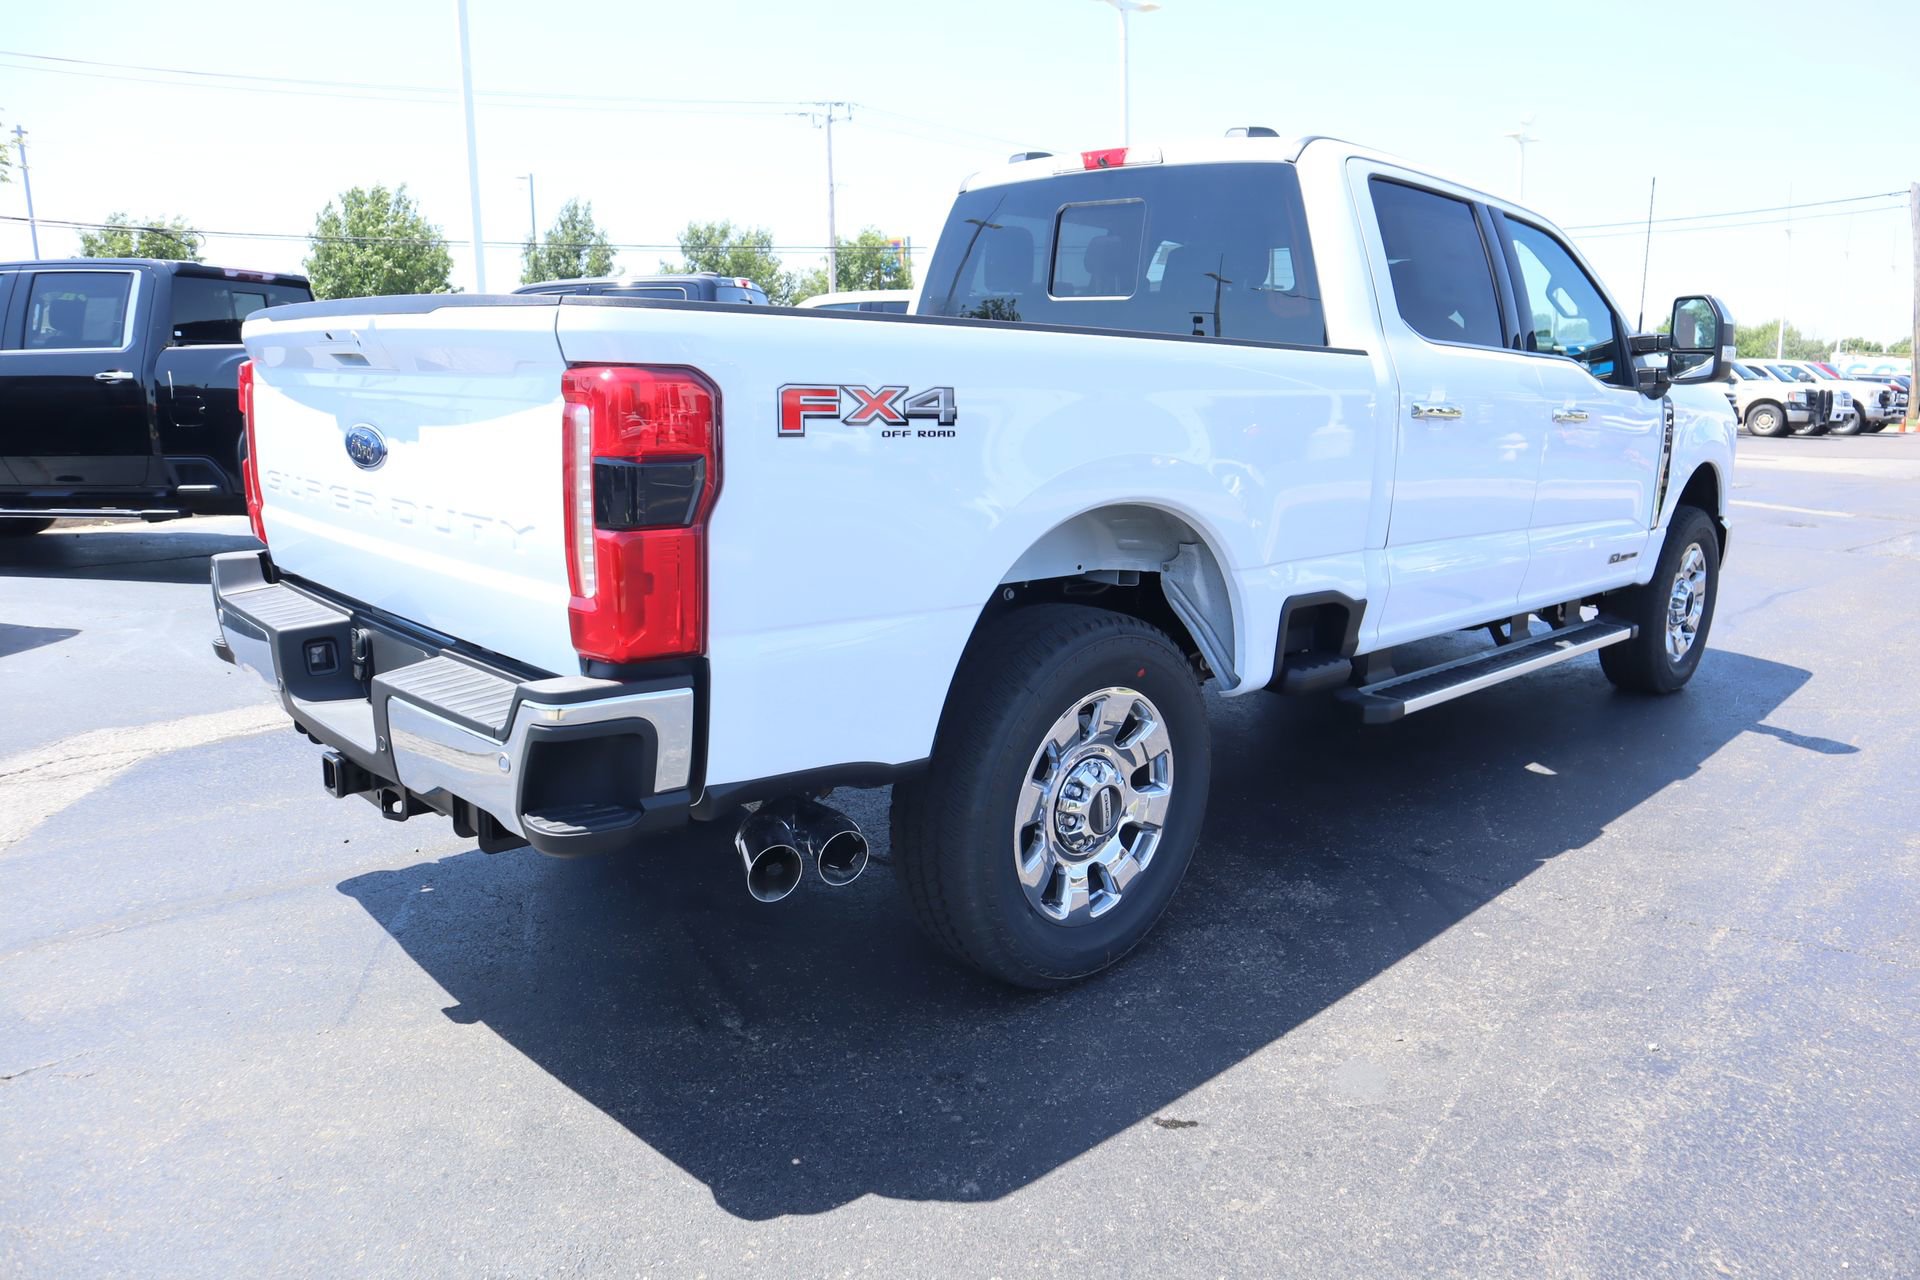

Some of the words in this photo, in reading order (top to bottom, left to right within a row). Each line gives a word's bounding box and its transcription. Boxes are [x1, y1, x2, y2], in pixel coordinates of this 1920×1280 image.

[777, 383, 957, 437] FX4
[351, 432, 375, 460] Ford
[881, 430, 912, 438] OFF
[917, 430, 956, 438] ROAD
[267, 470, 379, 516] SUPER
[392, 497, 535, 550] DUTY
